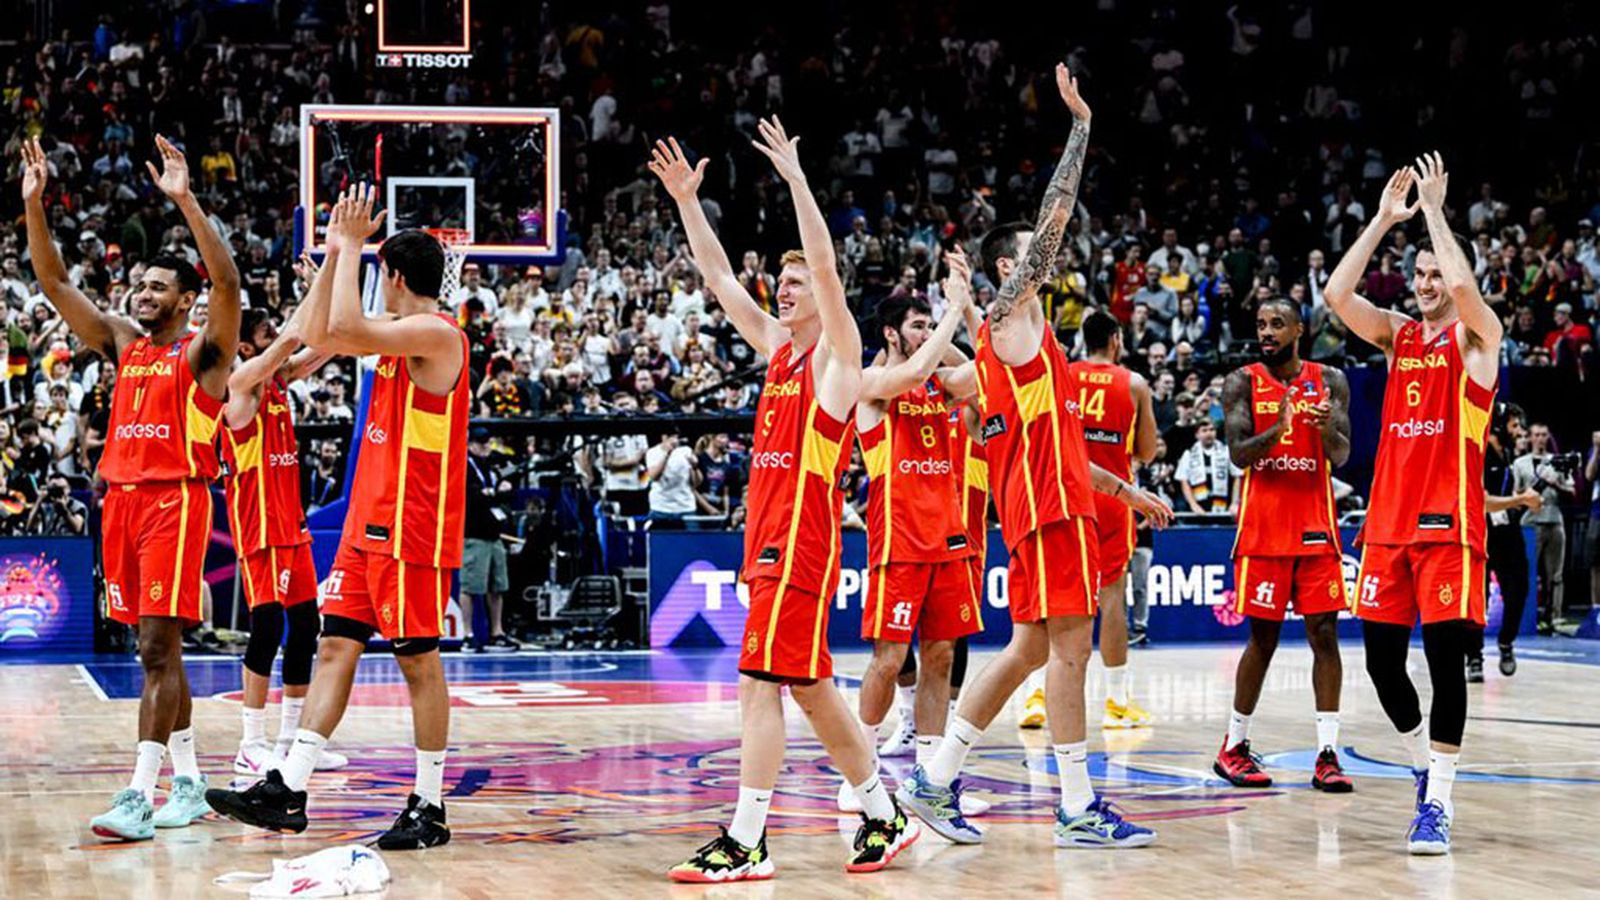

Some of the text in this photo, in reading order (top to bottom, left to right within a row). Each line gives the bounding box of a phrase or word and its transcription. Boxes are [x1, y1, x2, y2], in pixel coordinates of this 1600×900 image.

[402, 53, 473, 68] TISSOT
[1079, 387, 1105, 422] 14
[1406, 381, 1421, 407] 6
[115, 421, 170, 440] ndesa
[920, 425, 936, 448] 8
[1280, 425, 1293, 445] 2
[1389, 417, 1445, 438] ndesa
[1254, 453, 1317, 472] endesa
[1126, 564, 1227, 606] AME
[1256, 581, 1275, 604] fi
[893, 601, 912, 625] fi
